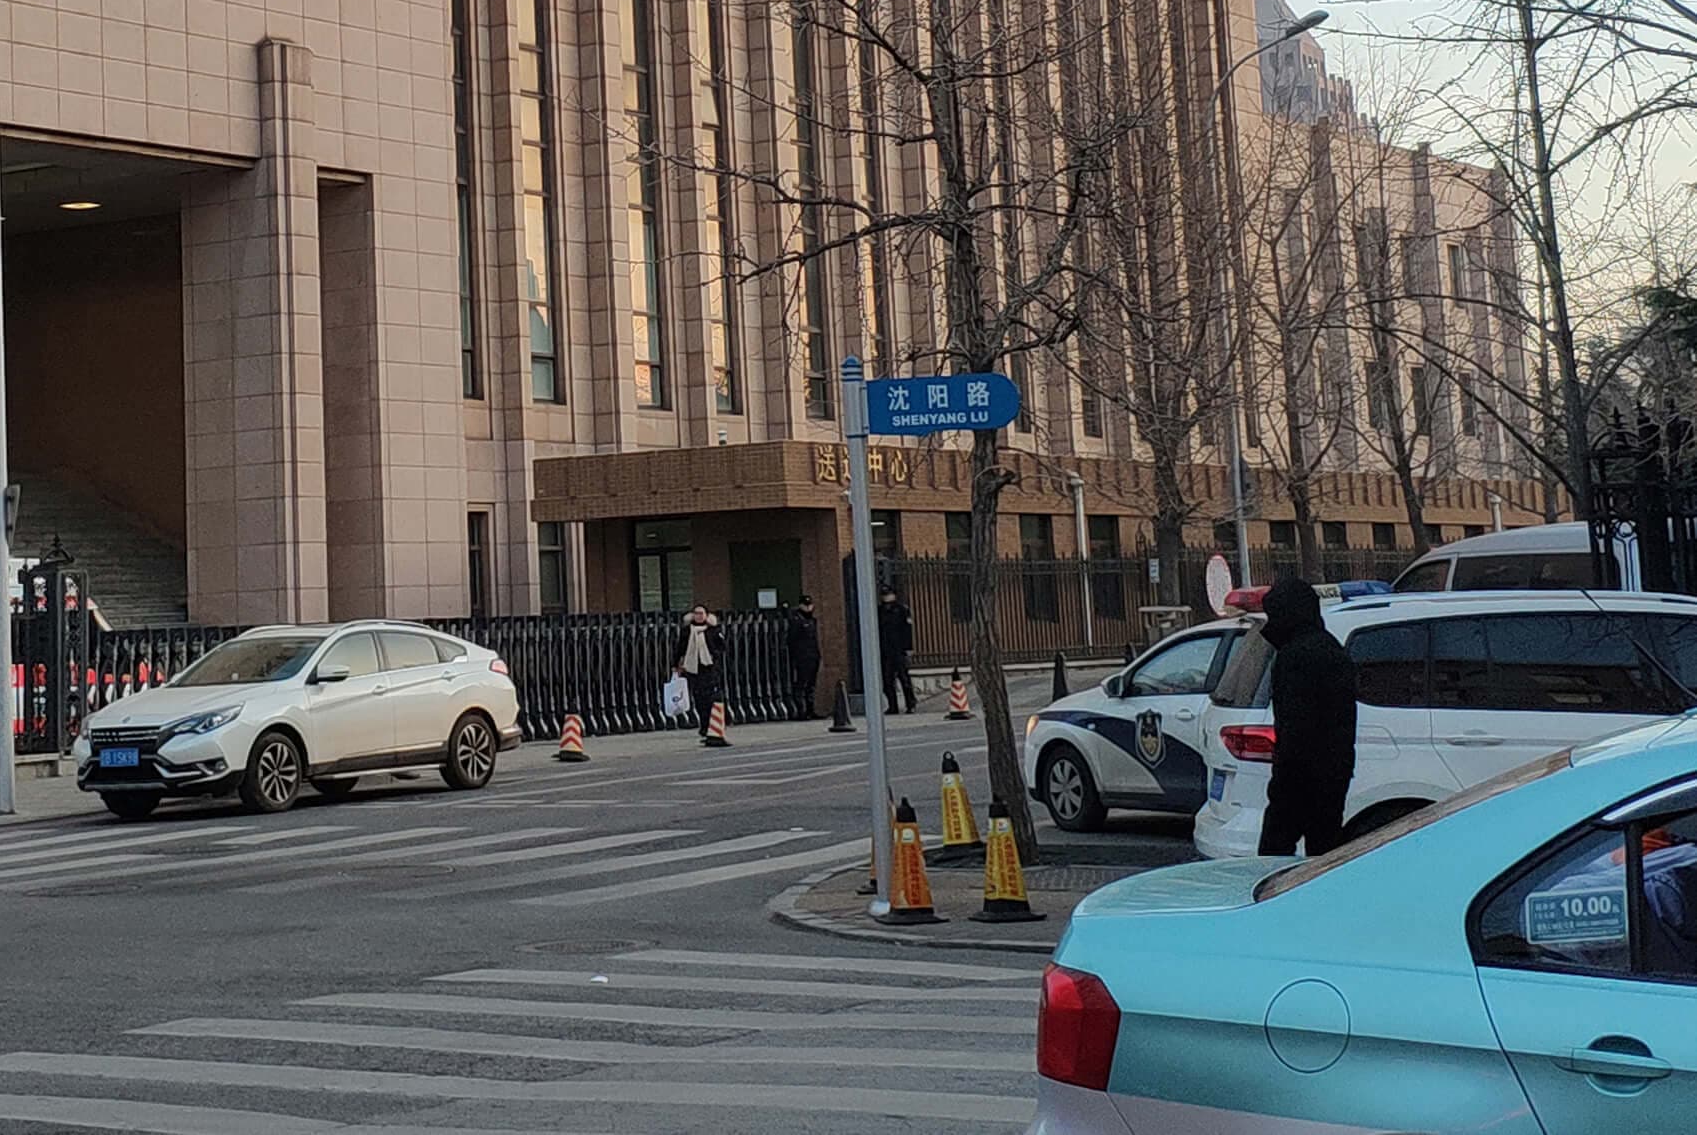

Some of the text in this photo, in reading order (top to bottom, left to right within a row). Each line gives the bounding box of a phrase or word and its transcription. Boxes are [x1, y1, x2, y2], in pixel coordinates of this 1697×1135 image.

[887, 380, 991, 411] 沈阳路
[892, 410, 989, 427] SHENYANG LU
